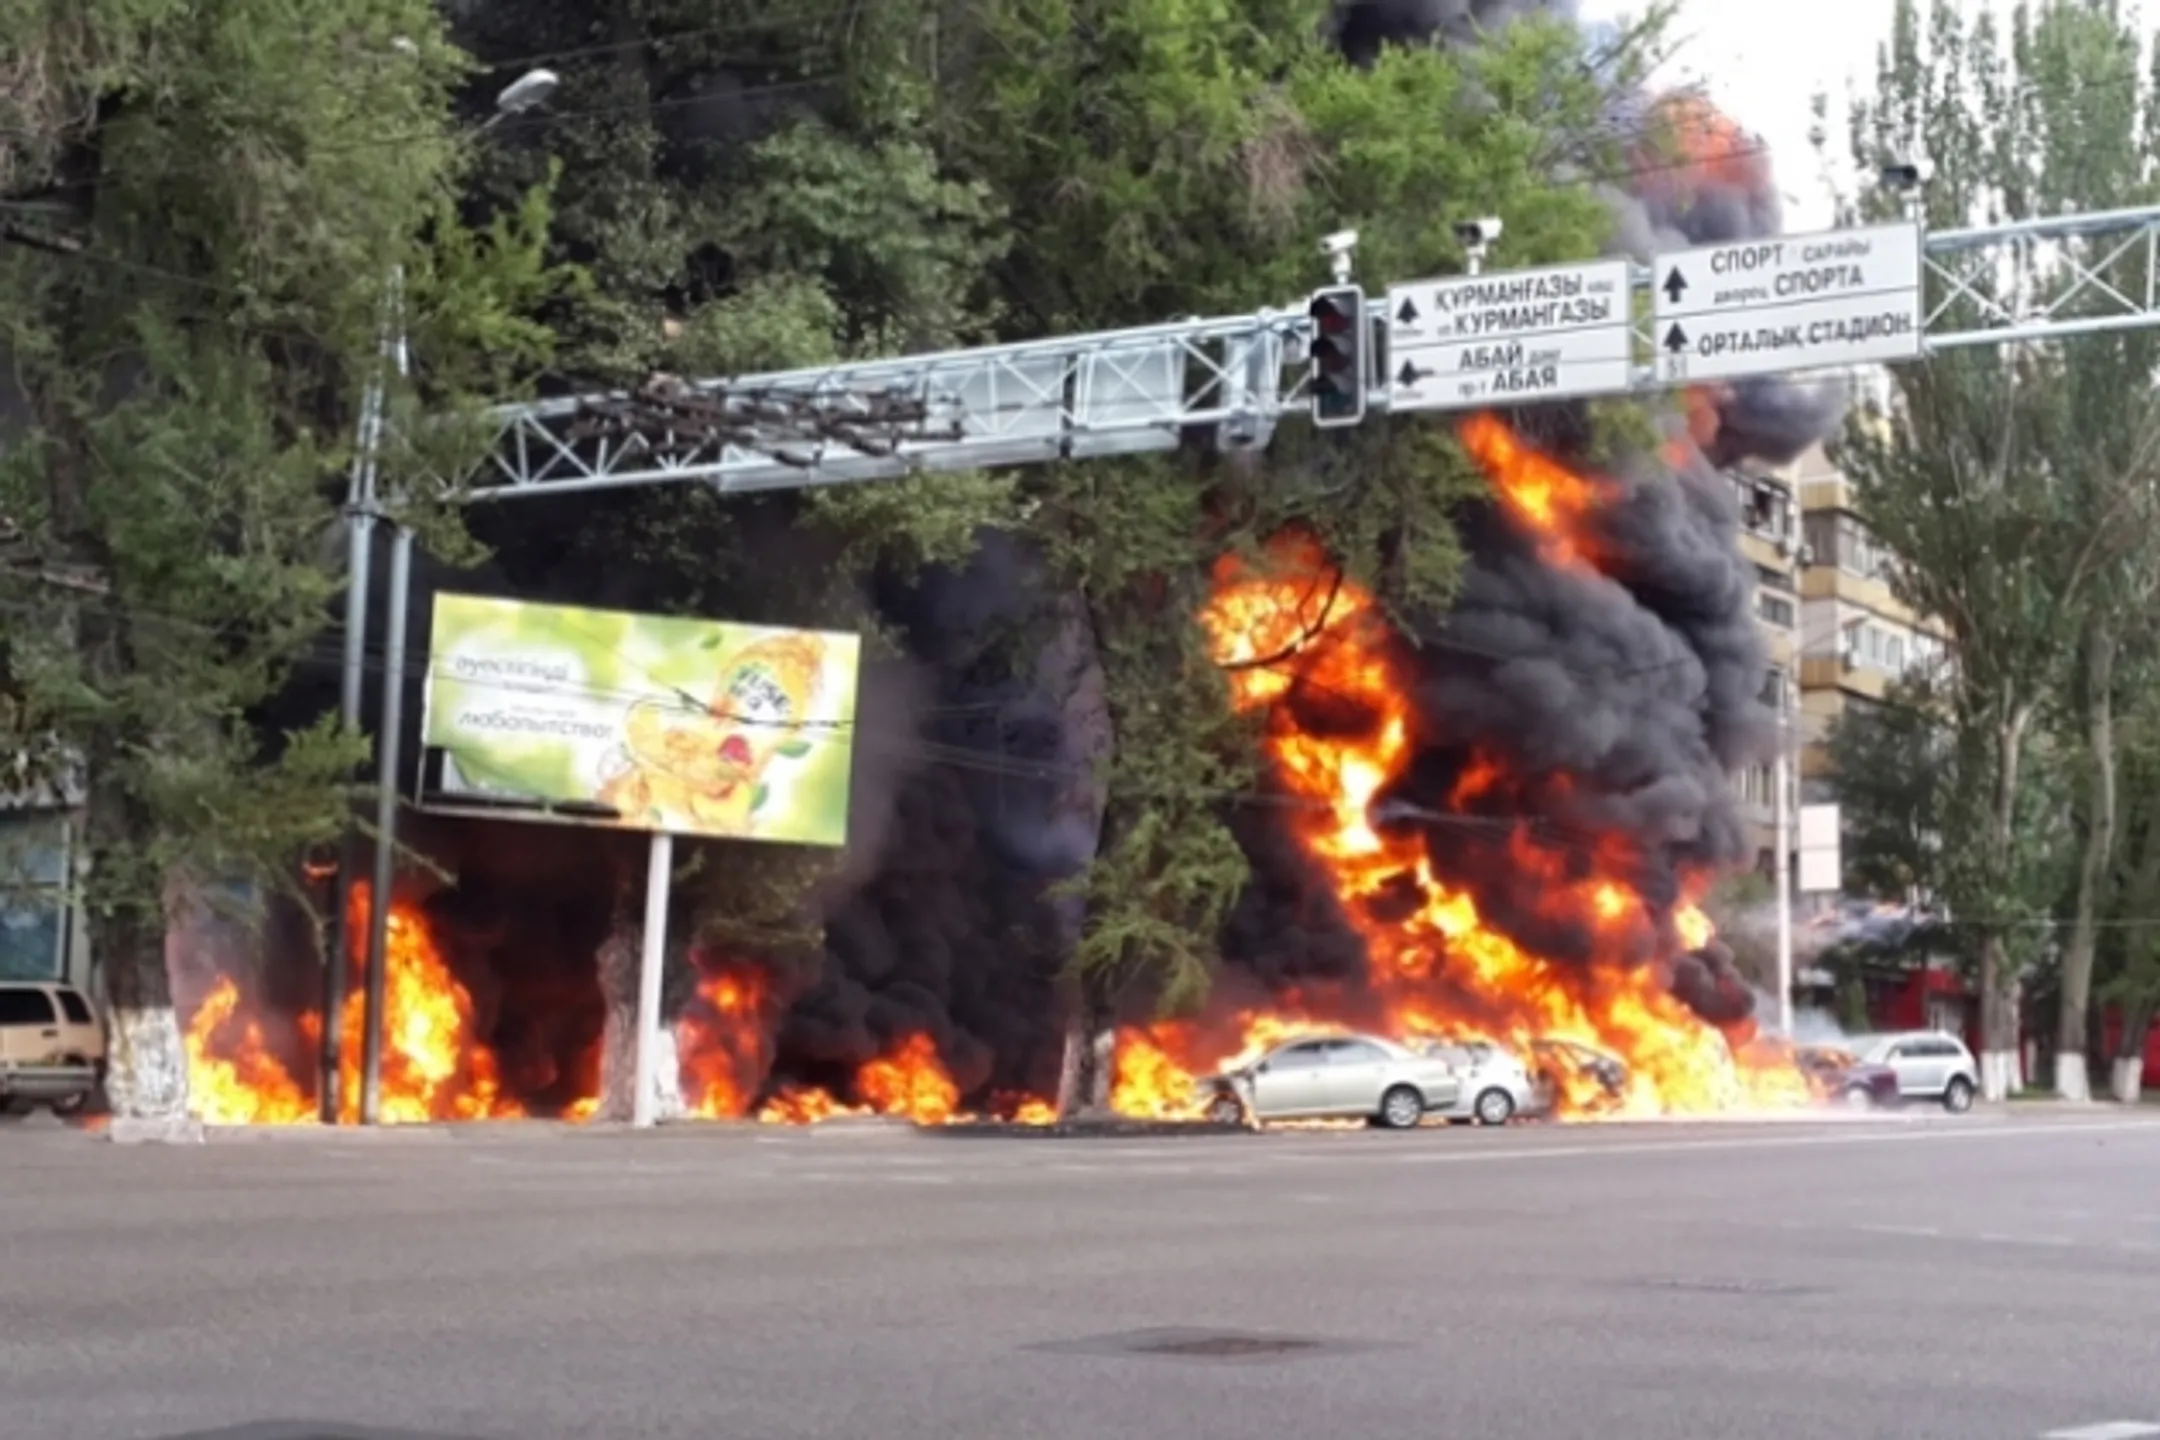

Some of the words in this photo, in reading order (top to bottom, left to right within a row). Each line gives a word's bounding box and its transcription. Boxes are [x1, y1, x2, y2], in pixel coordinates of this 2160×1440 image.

[1710, 244, 1783, 274] СПОРТ
[1774, 265, 1864, 296] СПОРТА
[1455, 297, 1610, 334] КУРМАНГАЗЫ
[1809, 312, 1911, 345] СТАДИОН
[1459, 339, 1523, 369] АБАЙ
[1492, 365, 1557, 391] АБАЯ
